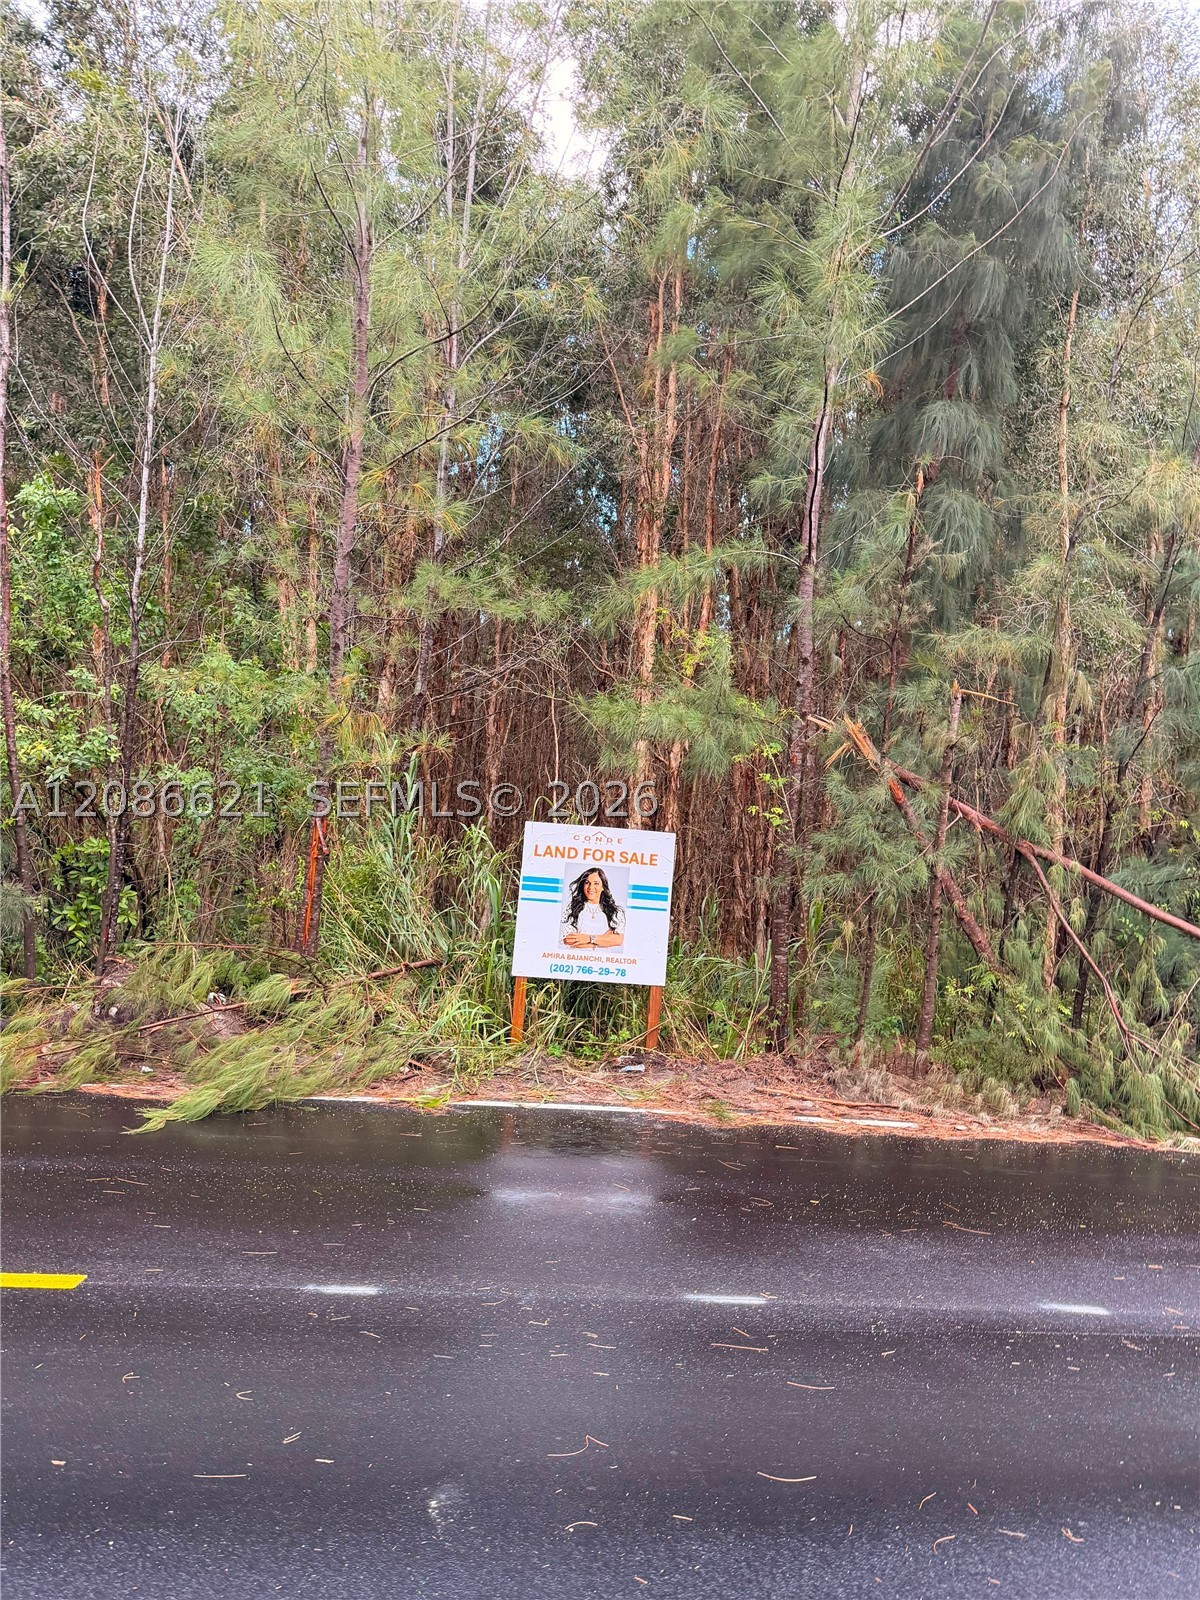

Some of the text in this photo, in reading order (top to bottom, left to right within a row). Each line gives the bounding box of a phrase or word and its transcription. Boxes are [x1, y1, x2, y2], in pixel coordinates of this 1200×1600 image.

[573, 835, 623, 844] CONDE
[534, 844, 658, 866] LAND FOR SALE
[542, 952, 565, 960] AMIRA
[605, 957, 637, 965] REALTOR
[550, 963, 627, 977] (202) 766-29-78
